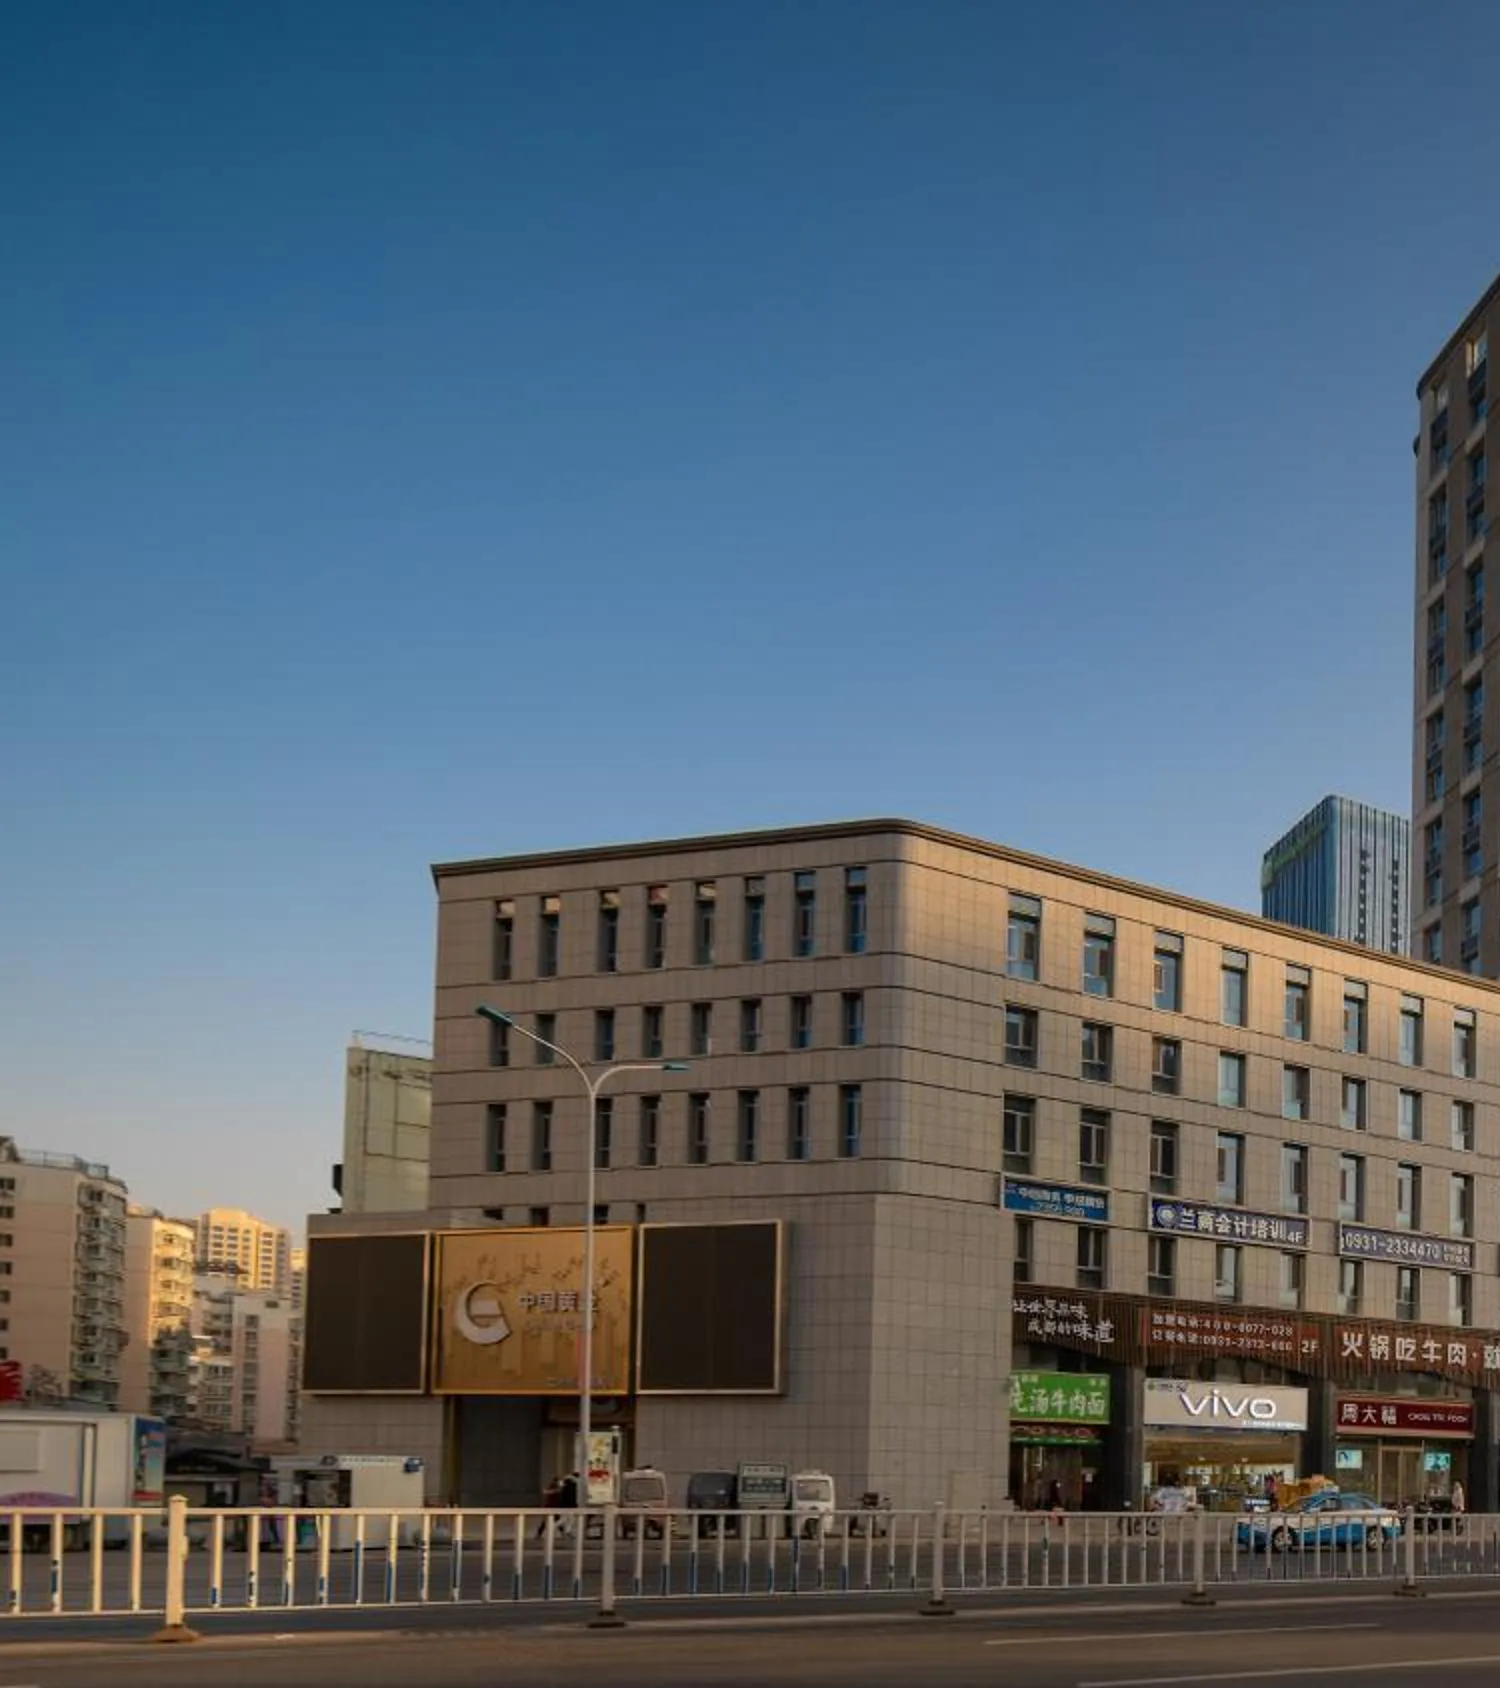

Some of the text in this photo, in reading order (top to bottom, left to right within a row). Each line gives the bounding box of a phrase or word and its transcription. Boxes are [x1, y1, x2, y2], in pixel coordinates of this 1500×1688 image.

[1180, 1388, 1277, 1419] vivo
[1340, 1403, 1397, 1425] 周大福
